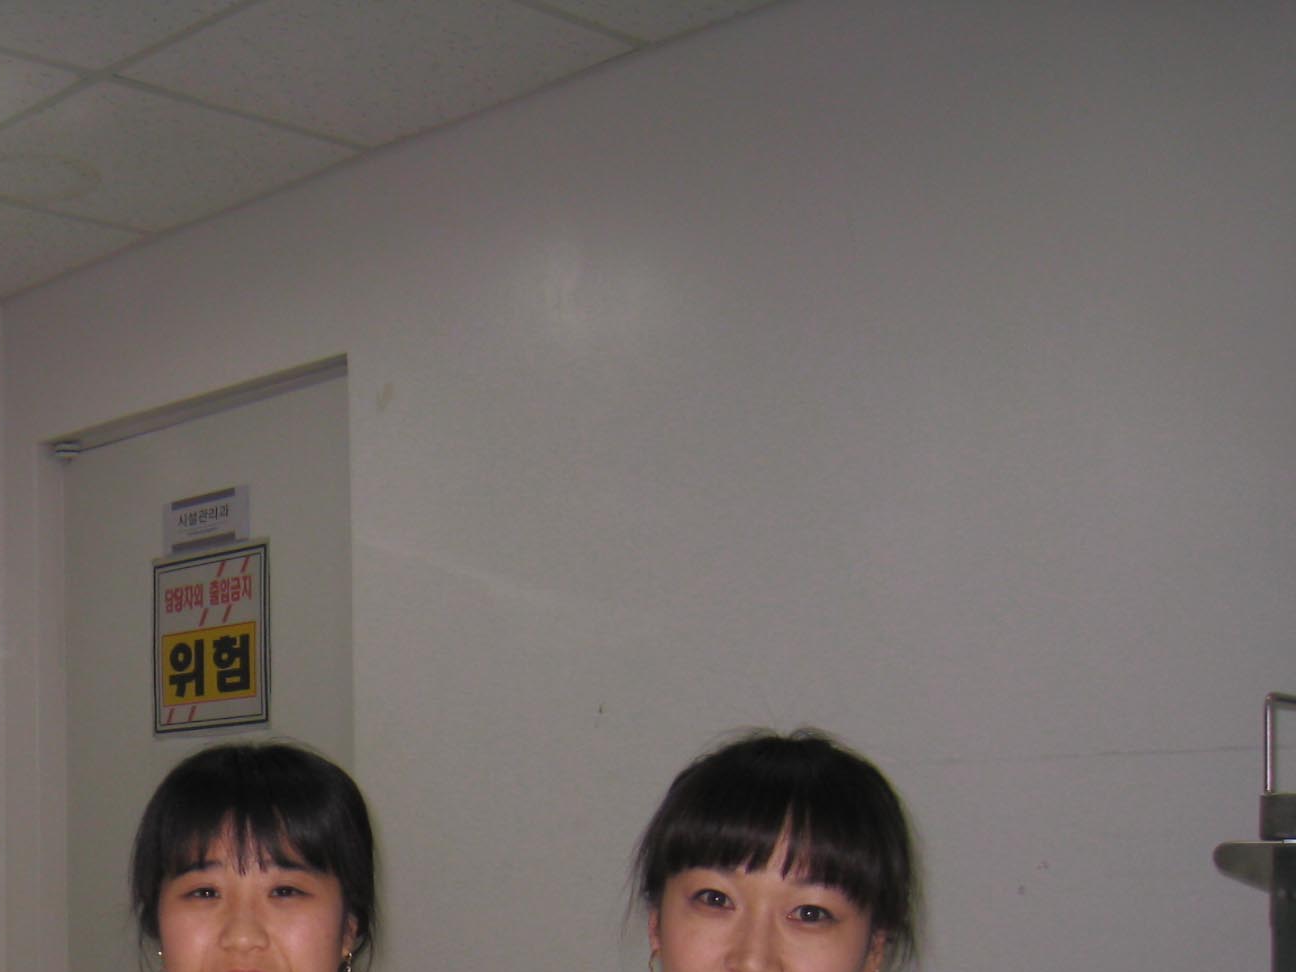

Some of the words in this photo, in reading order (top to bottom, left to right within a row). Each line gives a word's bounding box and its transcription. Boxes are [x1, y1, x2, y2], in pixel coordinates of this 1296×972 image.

[177, 503, 230, 528] 시설관리과
[208, 575, 252, 606] 출입금지
[168, 633, 251, 698] 위험
